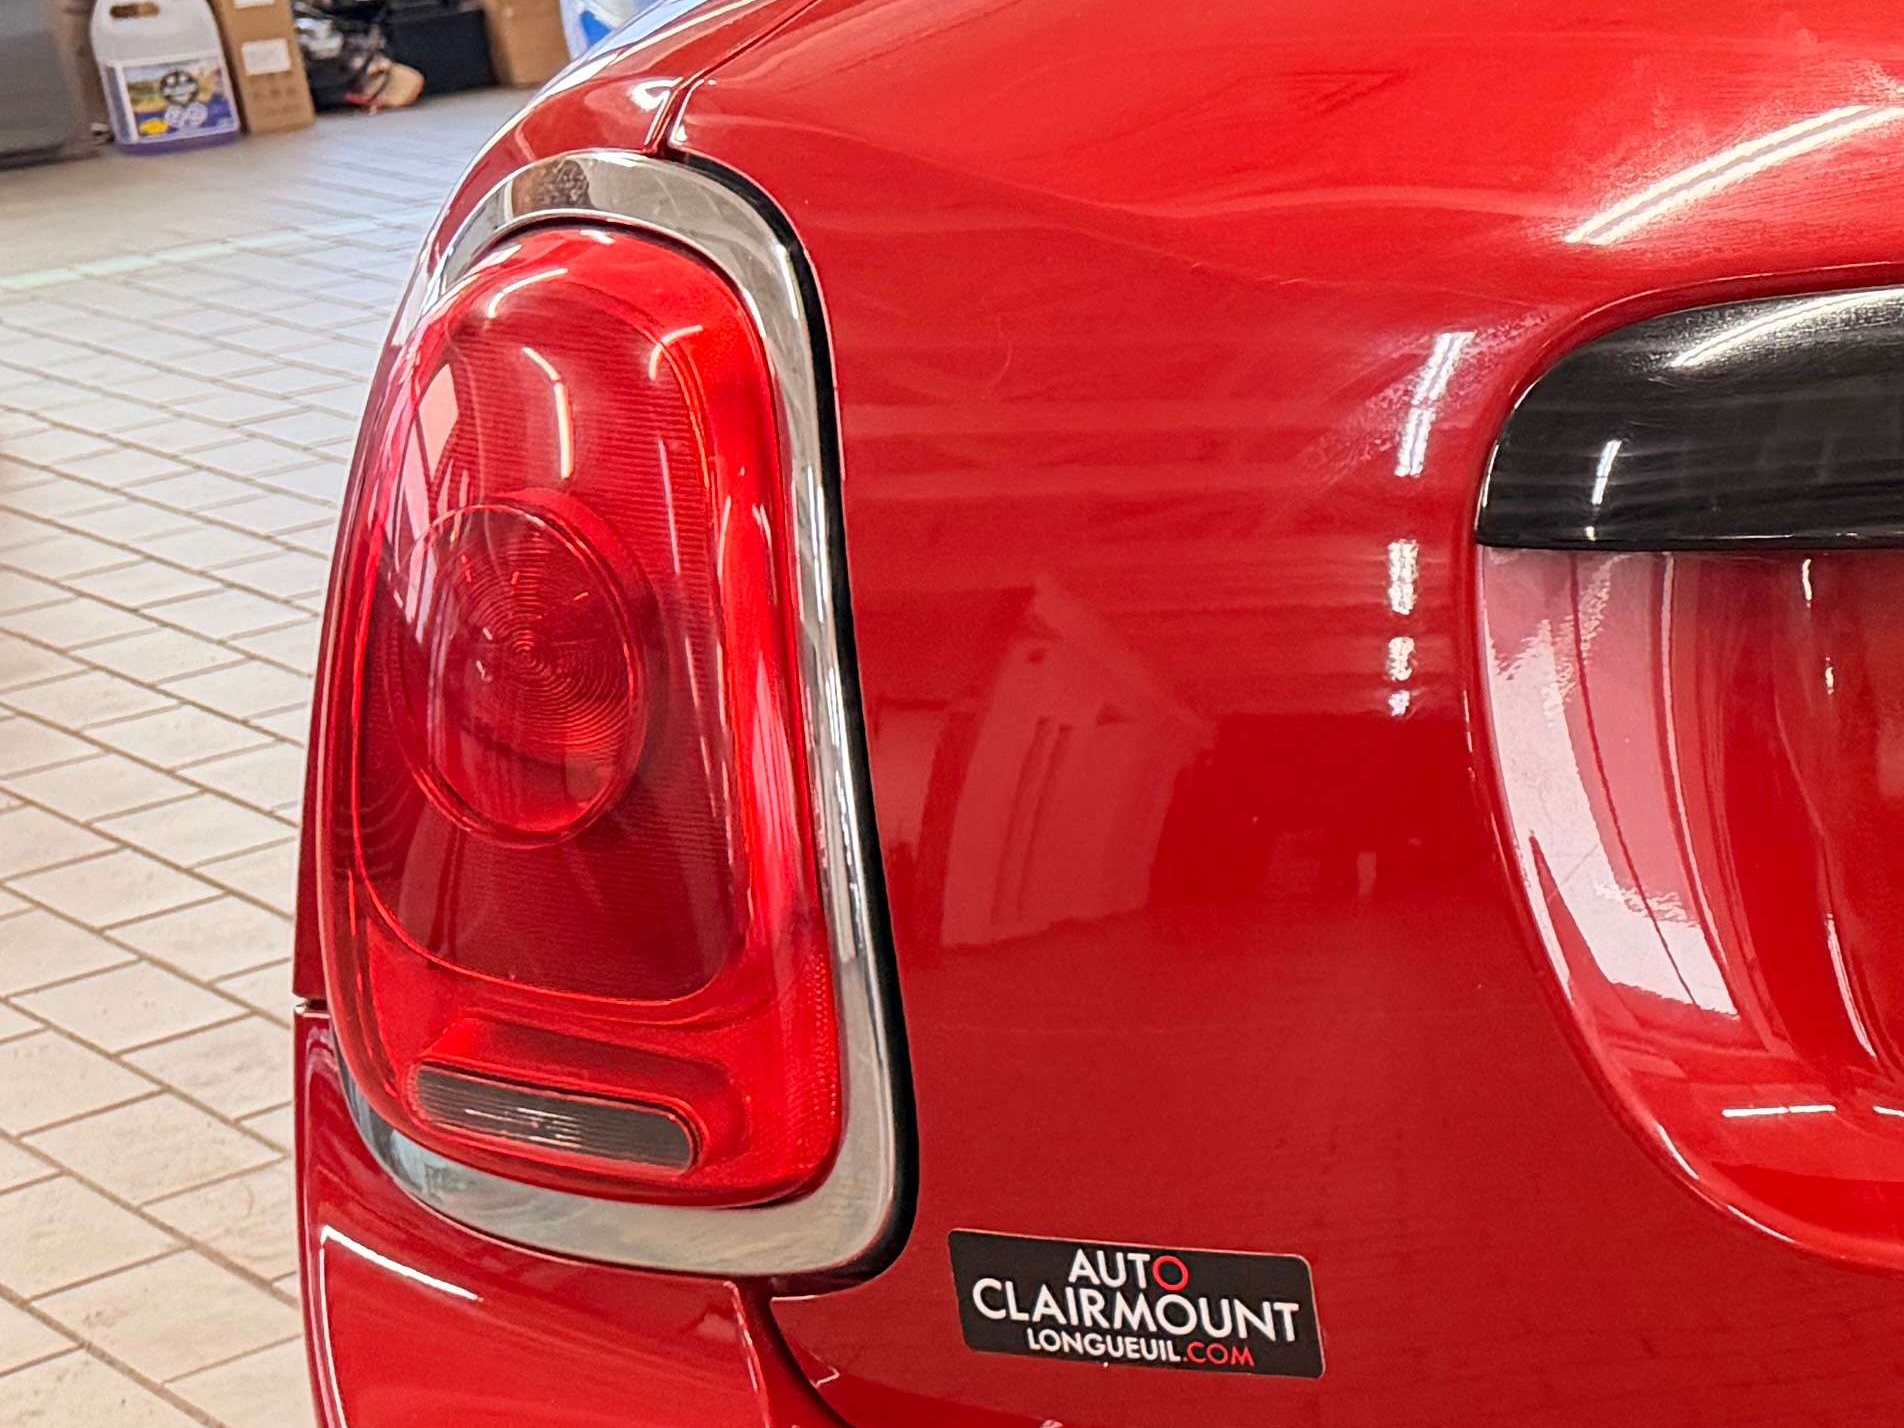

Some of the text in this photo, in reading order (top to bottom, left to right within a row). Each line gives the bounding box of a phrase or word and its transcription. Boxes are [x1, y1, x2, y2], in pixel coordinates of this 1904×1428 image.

[1068, 1247, 1189, 1291] AUTO
[972, 1277, 1300, 1342] CLAIRMOUNT
[1027, 1328, 1255, 1367] LONGUEUIL.COM
